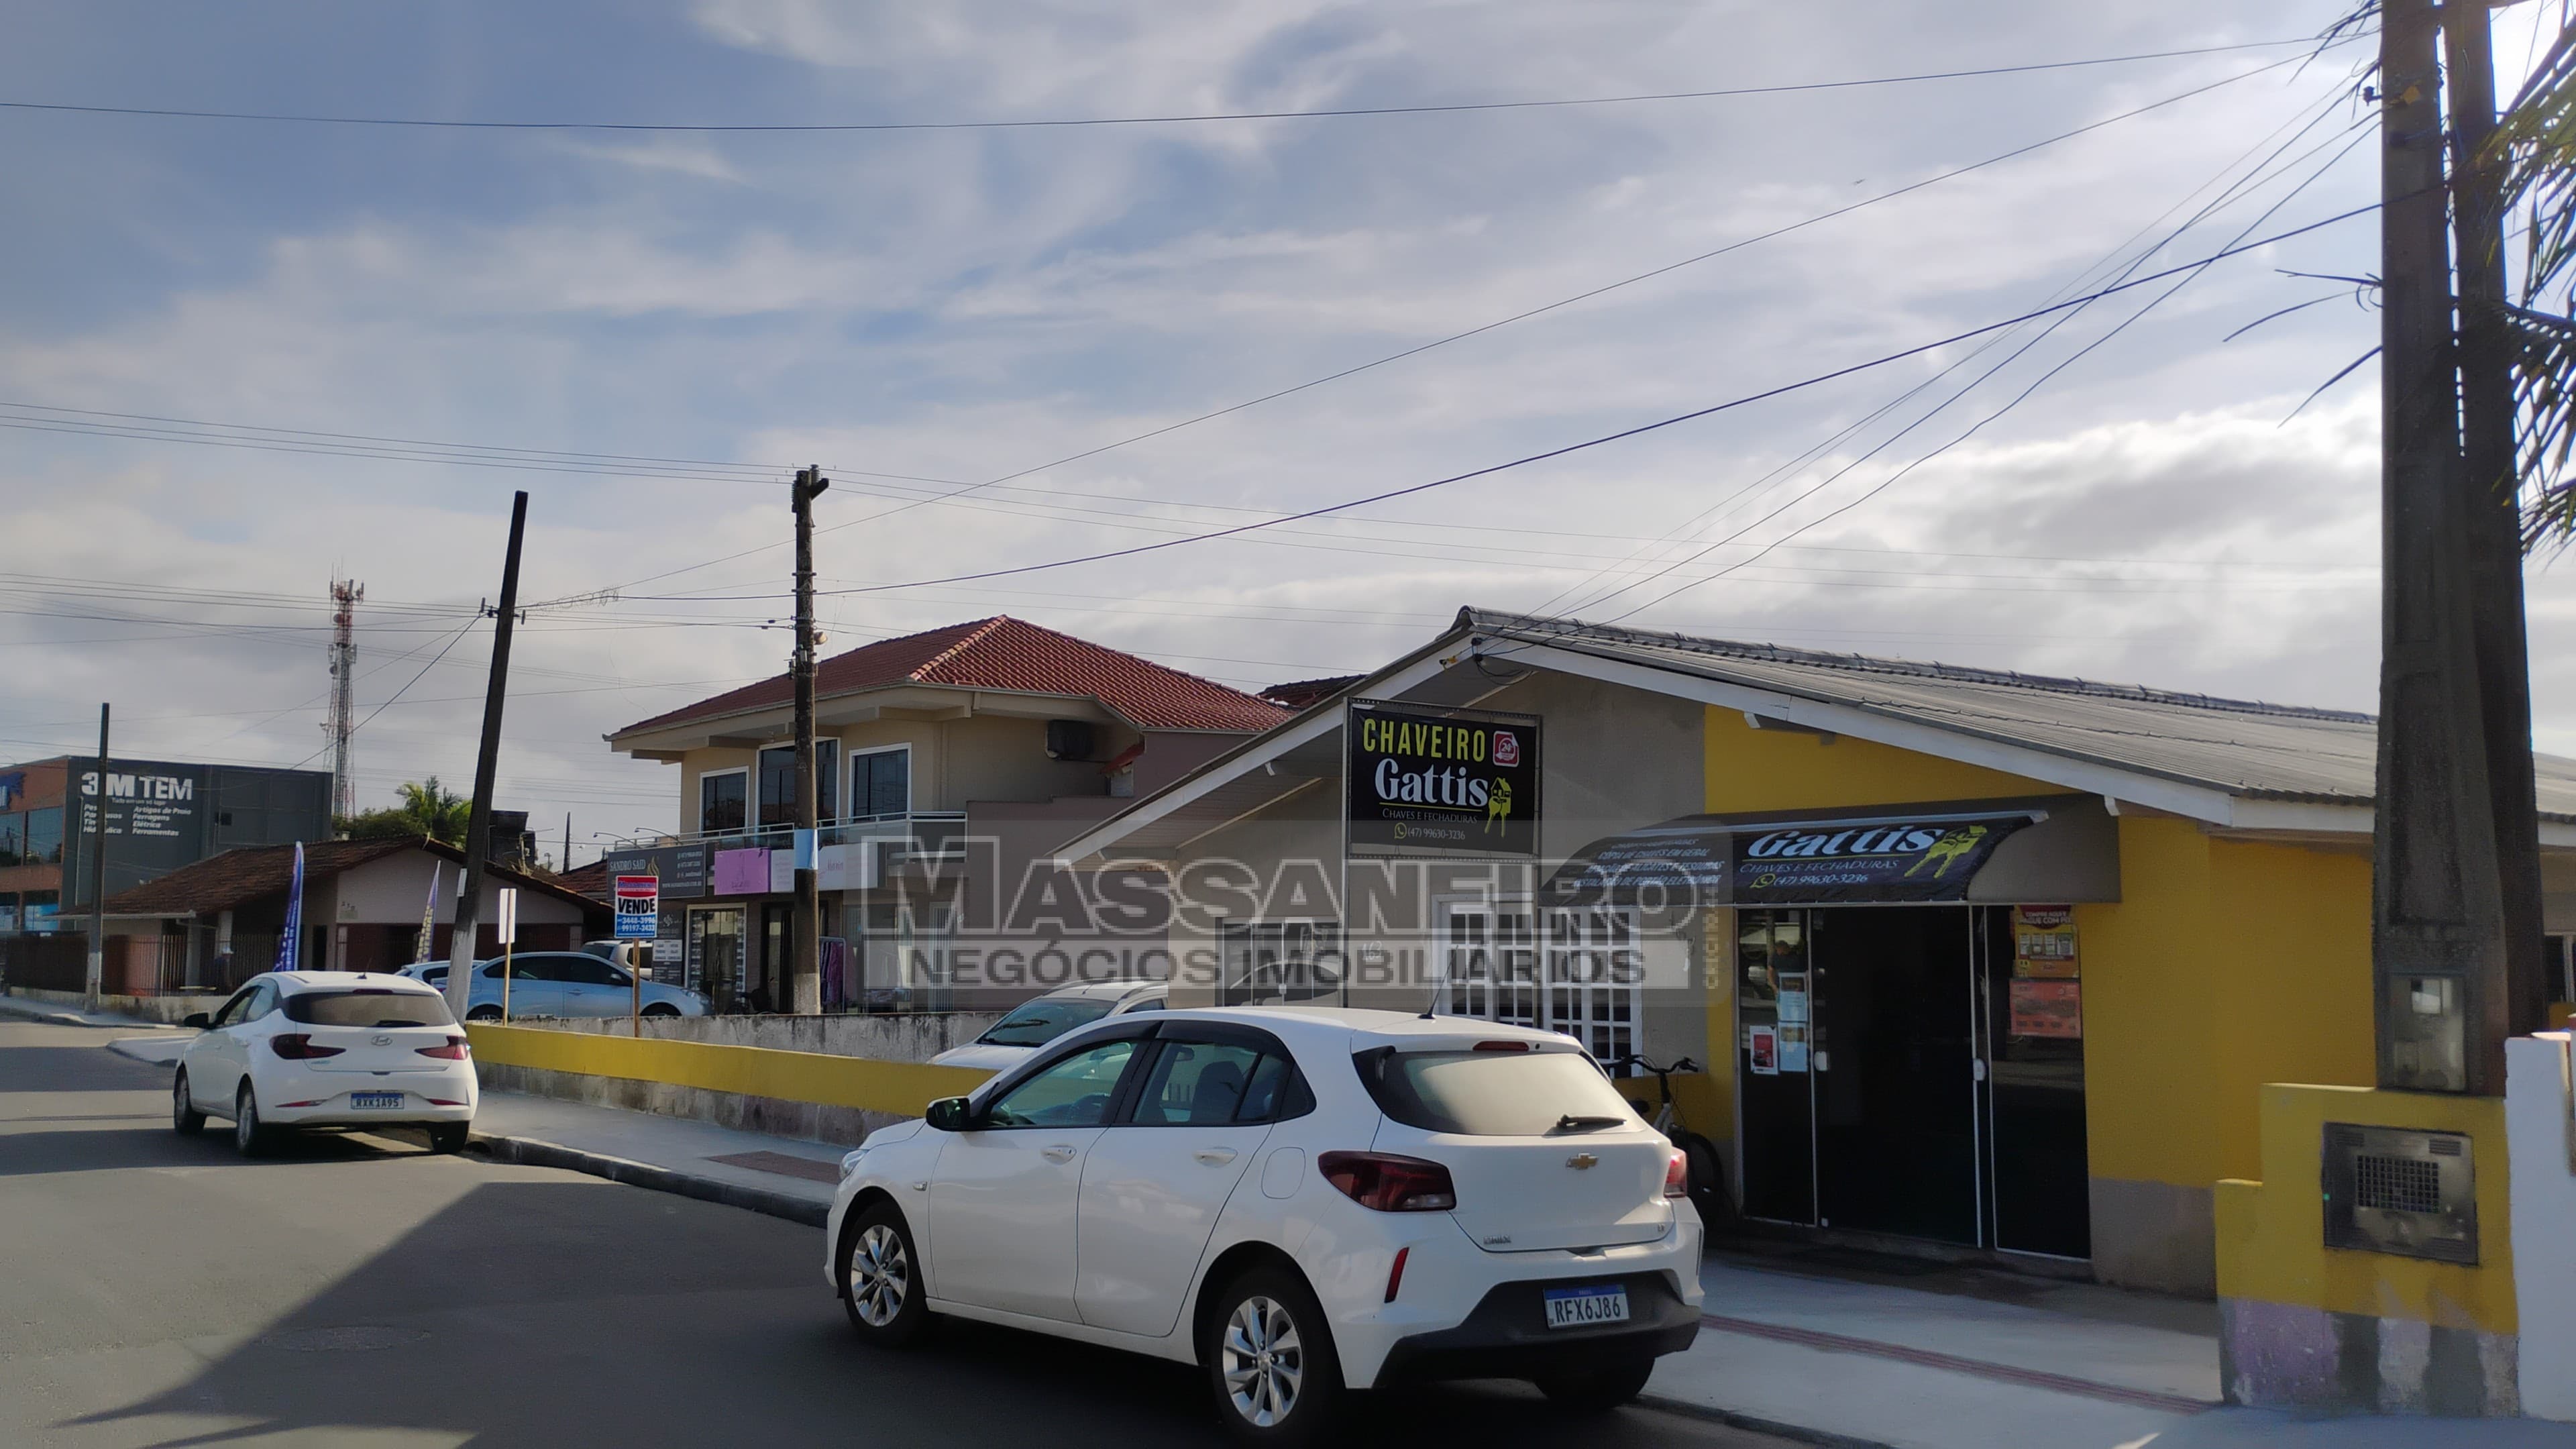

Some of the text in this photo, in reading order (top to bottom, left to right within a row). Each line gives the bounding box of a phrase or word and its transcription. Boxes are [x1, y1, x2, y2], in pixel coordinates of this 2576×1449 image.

[1363, 718, 1486, 763] CHAVEIRO
[139, 776, 193, 800] TEM
[1375, 757, 1489, 807] Gattis
[84, 811, 170, 822] Parusos Ferragens
[134, 806, 161, 814] Artigos
[1383, 808, 1477, 824] CHAVES E FECHADURAS
[132, 828, 179, 837] Ferramentas
[1408, 826, 1466, 840] (47) 99630-3236
[1748, 825, 1945, 857] Gattis
[1739, 859, 1900, 873] CHAVES E FECHADURAS
[1774, 874, 1869, 887] (47) 99630-3236
[618, 898, 655, 914] VENDE
[356, 1098, 400, 1108] RXK1A95
[1554, 1296, 1621, 1323] RFX6J86
